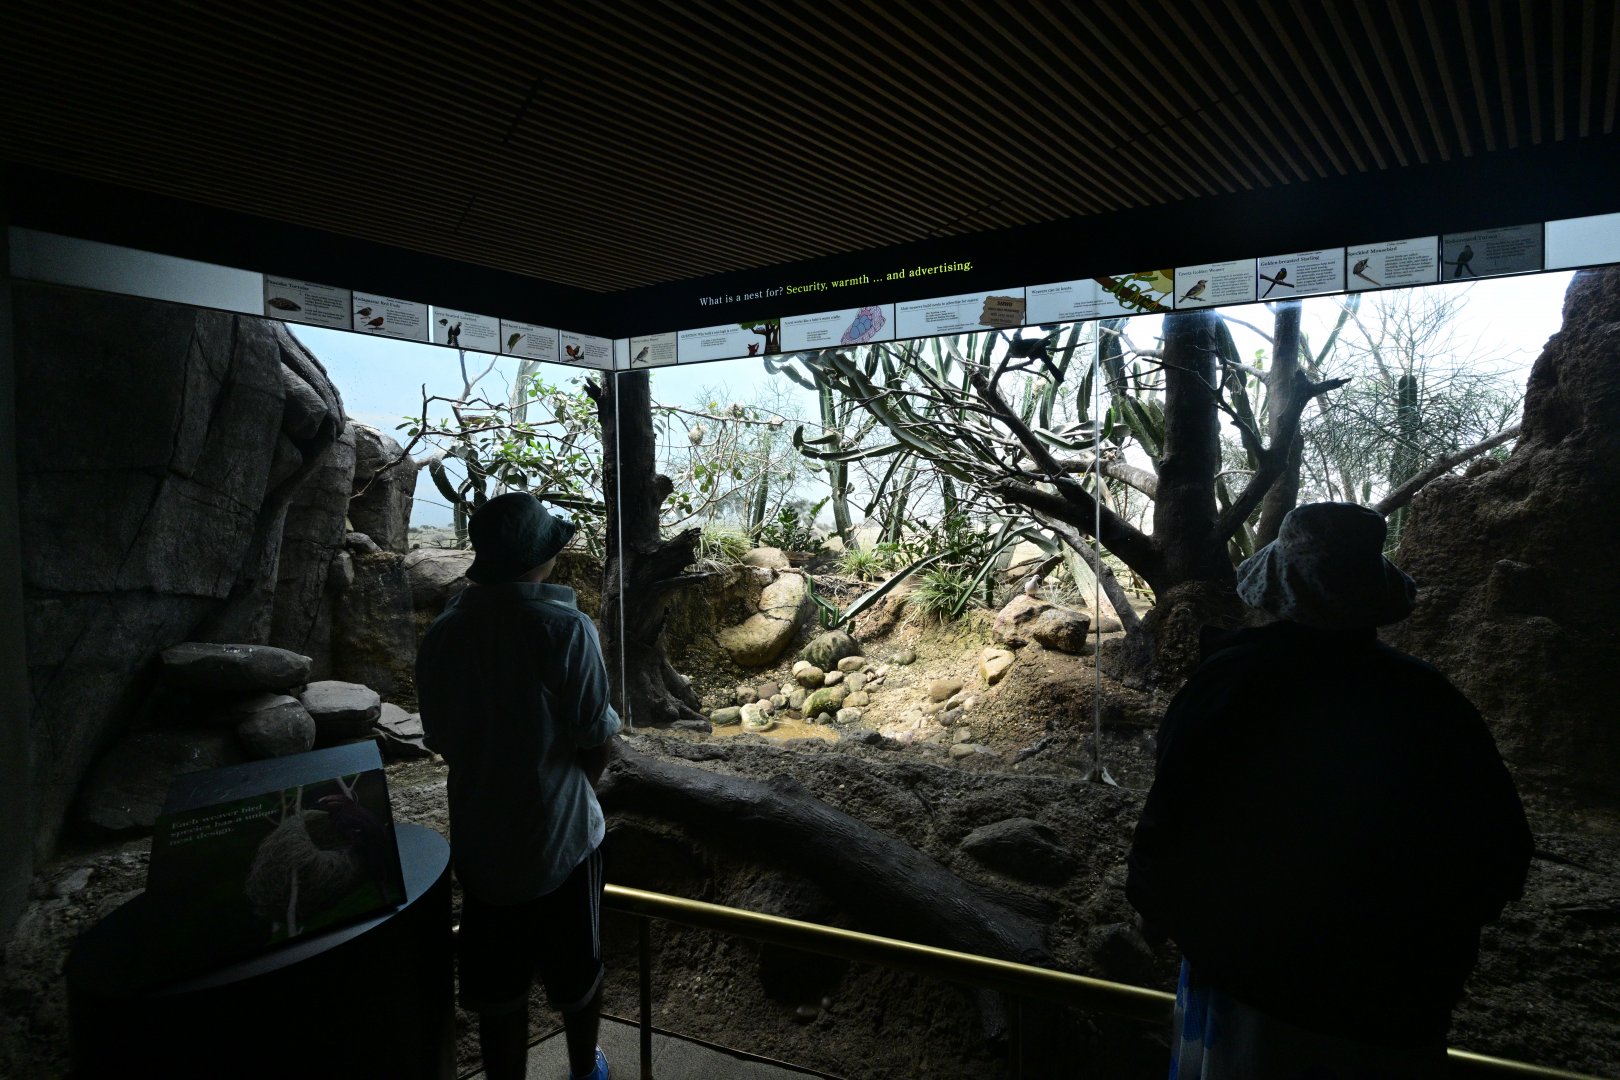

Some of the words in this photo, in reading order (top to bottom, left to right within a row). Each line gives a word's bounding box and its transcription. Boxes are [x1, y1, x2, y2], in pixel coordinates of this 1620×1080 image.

[699, 297, 723, 307] What
[725, 294, 734, 303] is
[744, 291, 763, 300] nest
[766, 287, 784, 297] for?
[786, 281, 828, 295] Security,
[831, 275, 869, 288] warmth
[886, 269, 905, 281] and
[909, 261, 974, 278] advertising.
[168, 825, 212, 838] species
[214, 819, 234, 828] has
[244, 808, 280, 819] unique
[171, 818, 199, 830] Each
[202, 810, 240, 823] weaver
[242, 803, 262, 813] bird
[168, 836, 194, 847] nest
